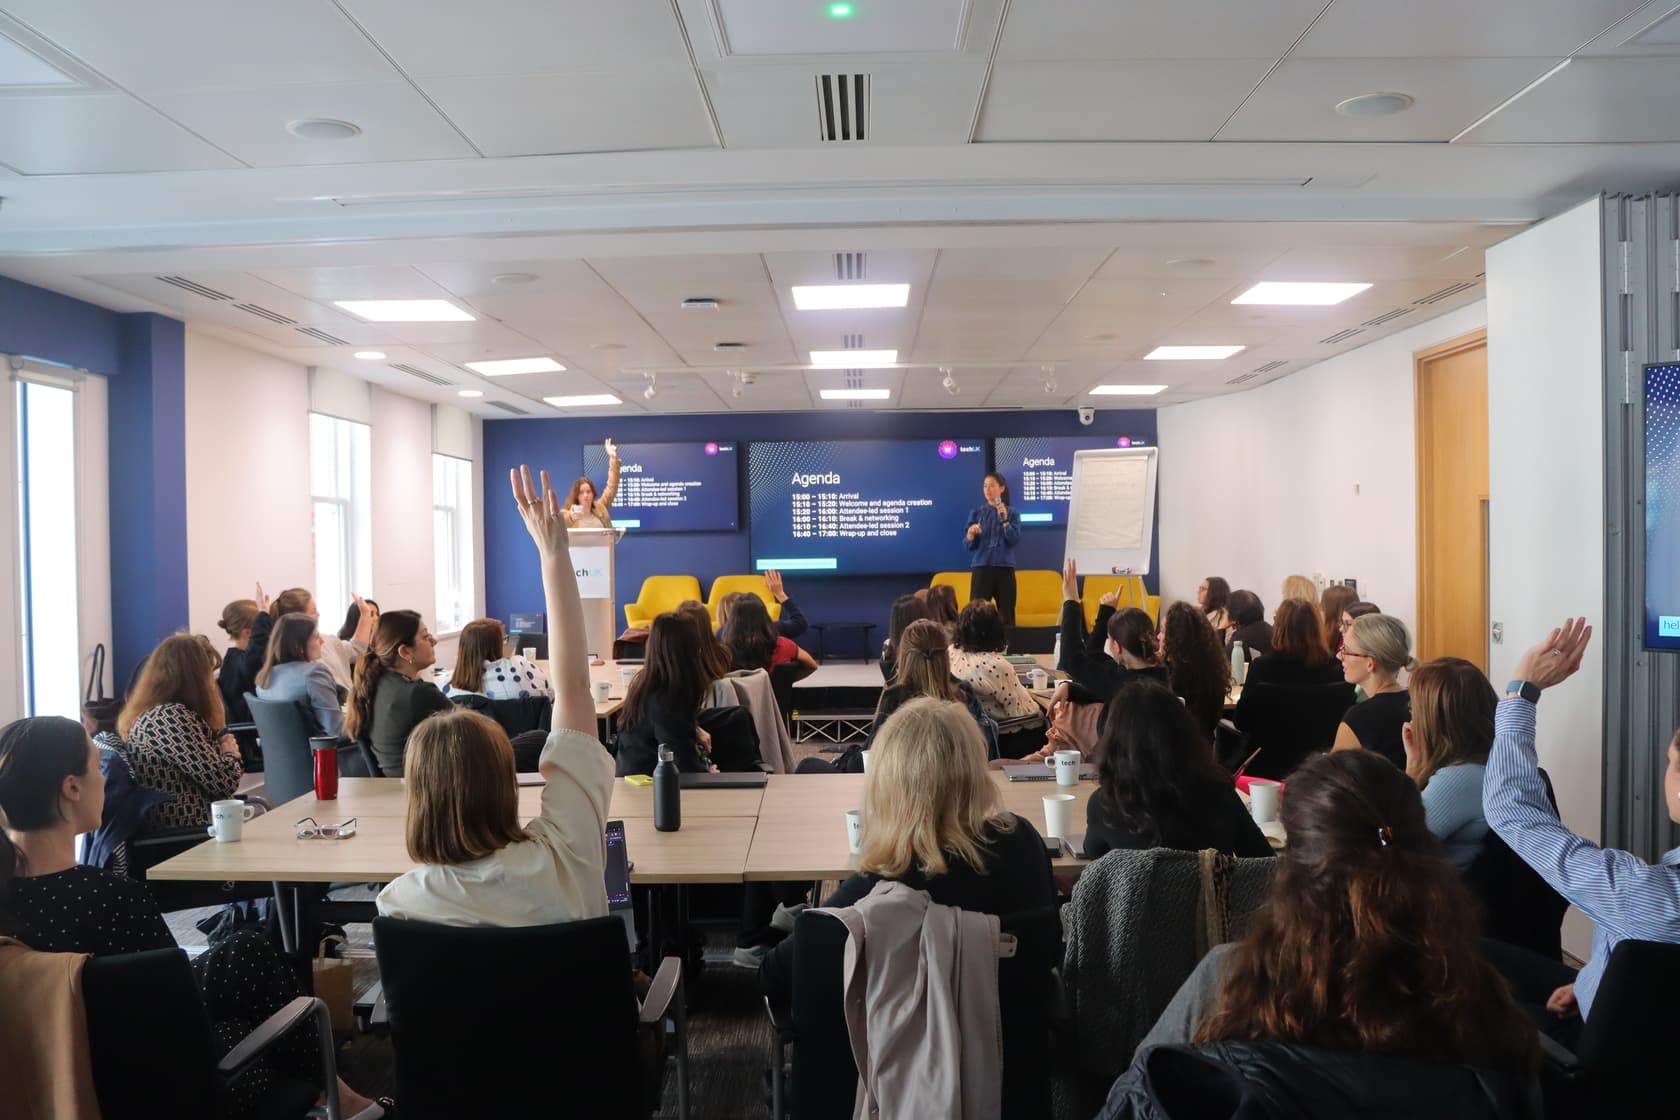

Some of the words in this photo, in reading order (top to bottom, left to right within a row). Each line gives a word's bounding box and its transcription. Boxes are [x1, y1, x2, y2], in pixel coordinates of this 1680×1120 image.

[1023, 457, 1055, 468] Agenda
[620, 464, 642, 474] enda
[791, 471, 841, 488] Agenda
[839, 492, 859, 500] Arrival
[869, 499, 881, 507] and
[882, 500, 906, 508] agenda
[839, 530, 866, 538] Wrap-up
[576, 567, 605, 577] chUK
